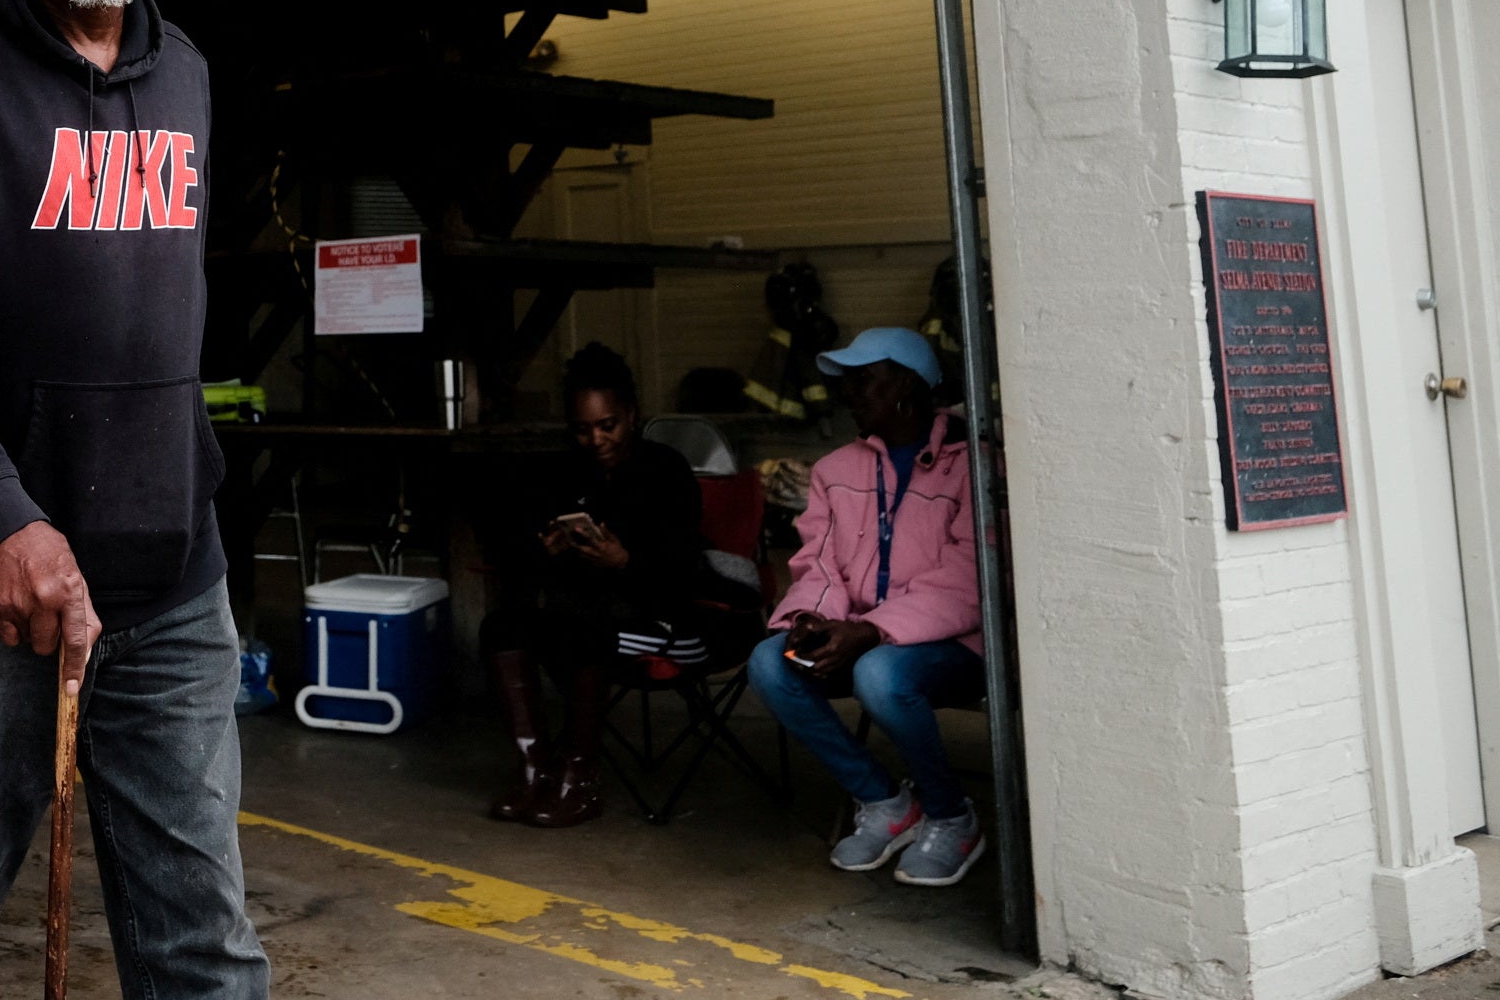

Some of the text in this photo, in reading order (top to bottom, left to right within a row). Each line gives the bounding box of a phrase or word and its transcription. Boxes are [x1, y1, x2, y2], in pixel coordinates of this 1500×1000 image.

[30, 127, 198, 231] NIKE
[330, 245, 359, 256] NOTICE
[361, 244, 371, 254] TO
[1226, 239, 1308, 261] FIRE DEPARTMENT
